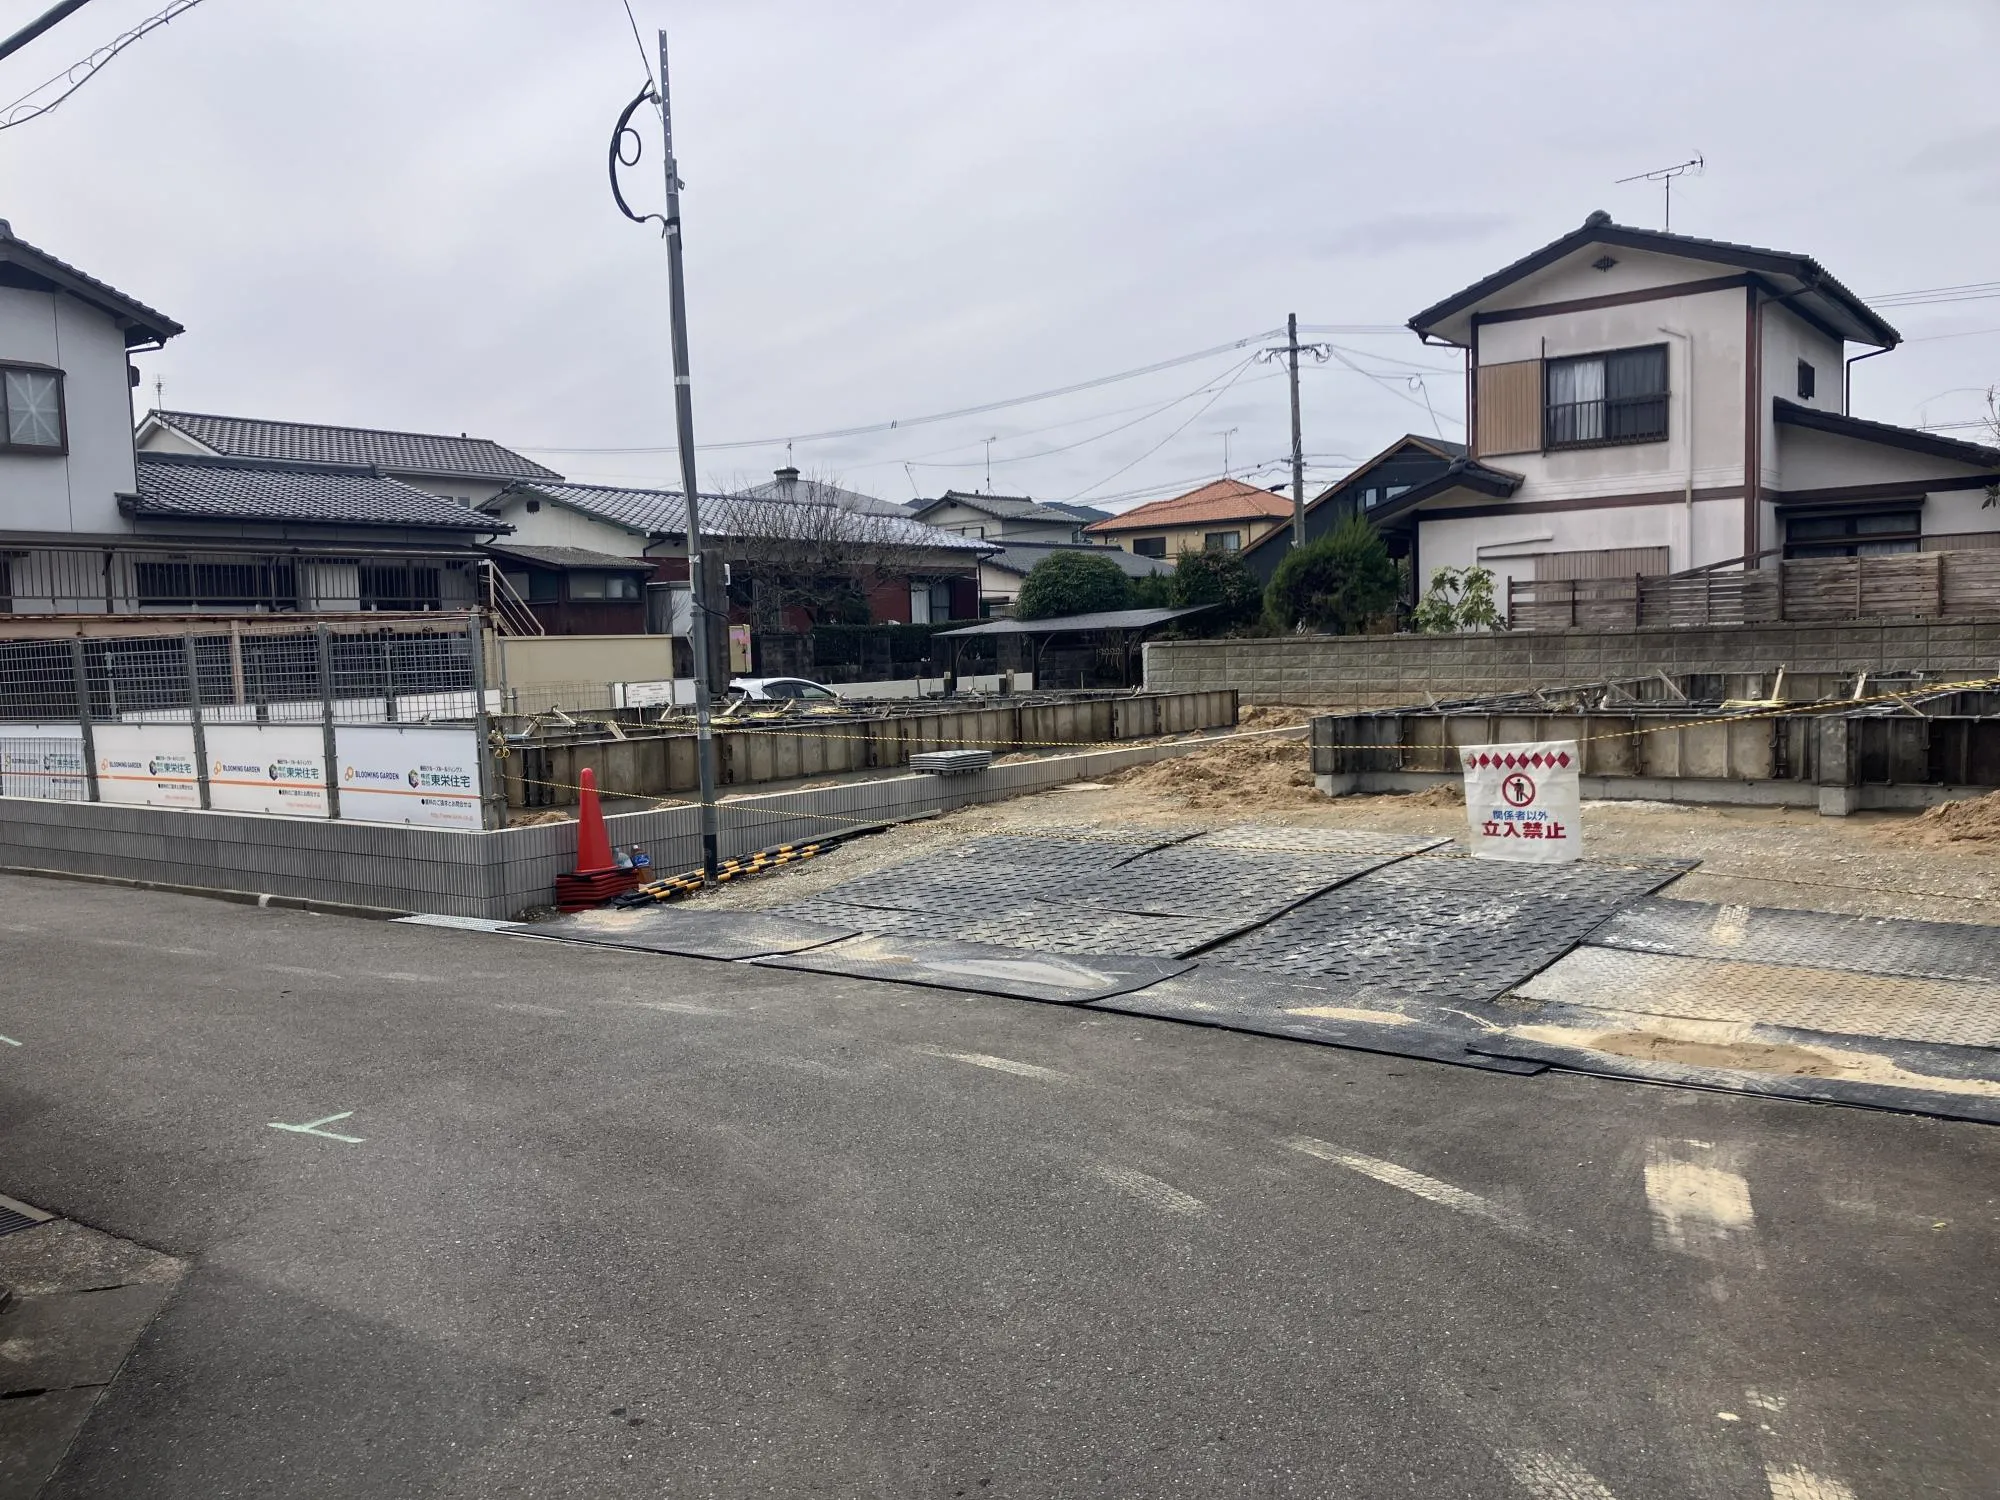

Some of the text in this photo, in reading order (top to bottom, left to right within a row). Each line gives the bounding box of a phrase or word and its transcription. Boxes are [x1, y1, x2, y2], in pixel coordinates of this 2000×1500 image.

[222, 764, 261, 773] BLOOMING GARDEN
[286, 766, 319, 779] 東栄住宅
[355, 770, 400, 781] BLOOMING GARDEN
[430, 773, 471, 788] 東栄住宅
[1492, 810, 1548, 821] 関係者以外
[1481, 820, 1567, 839] 立入禁止
